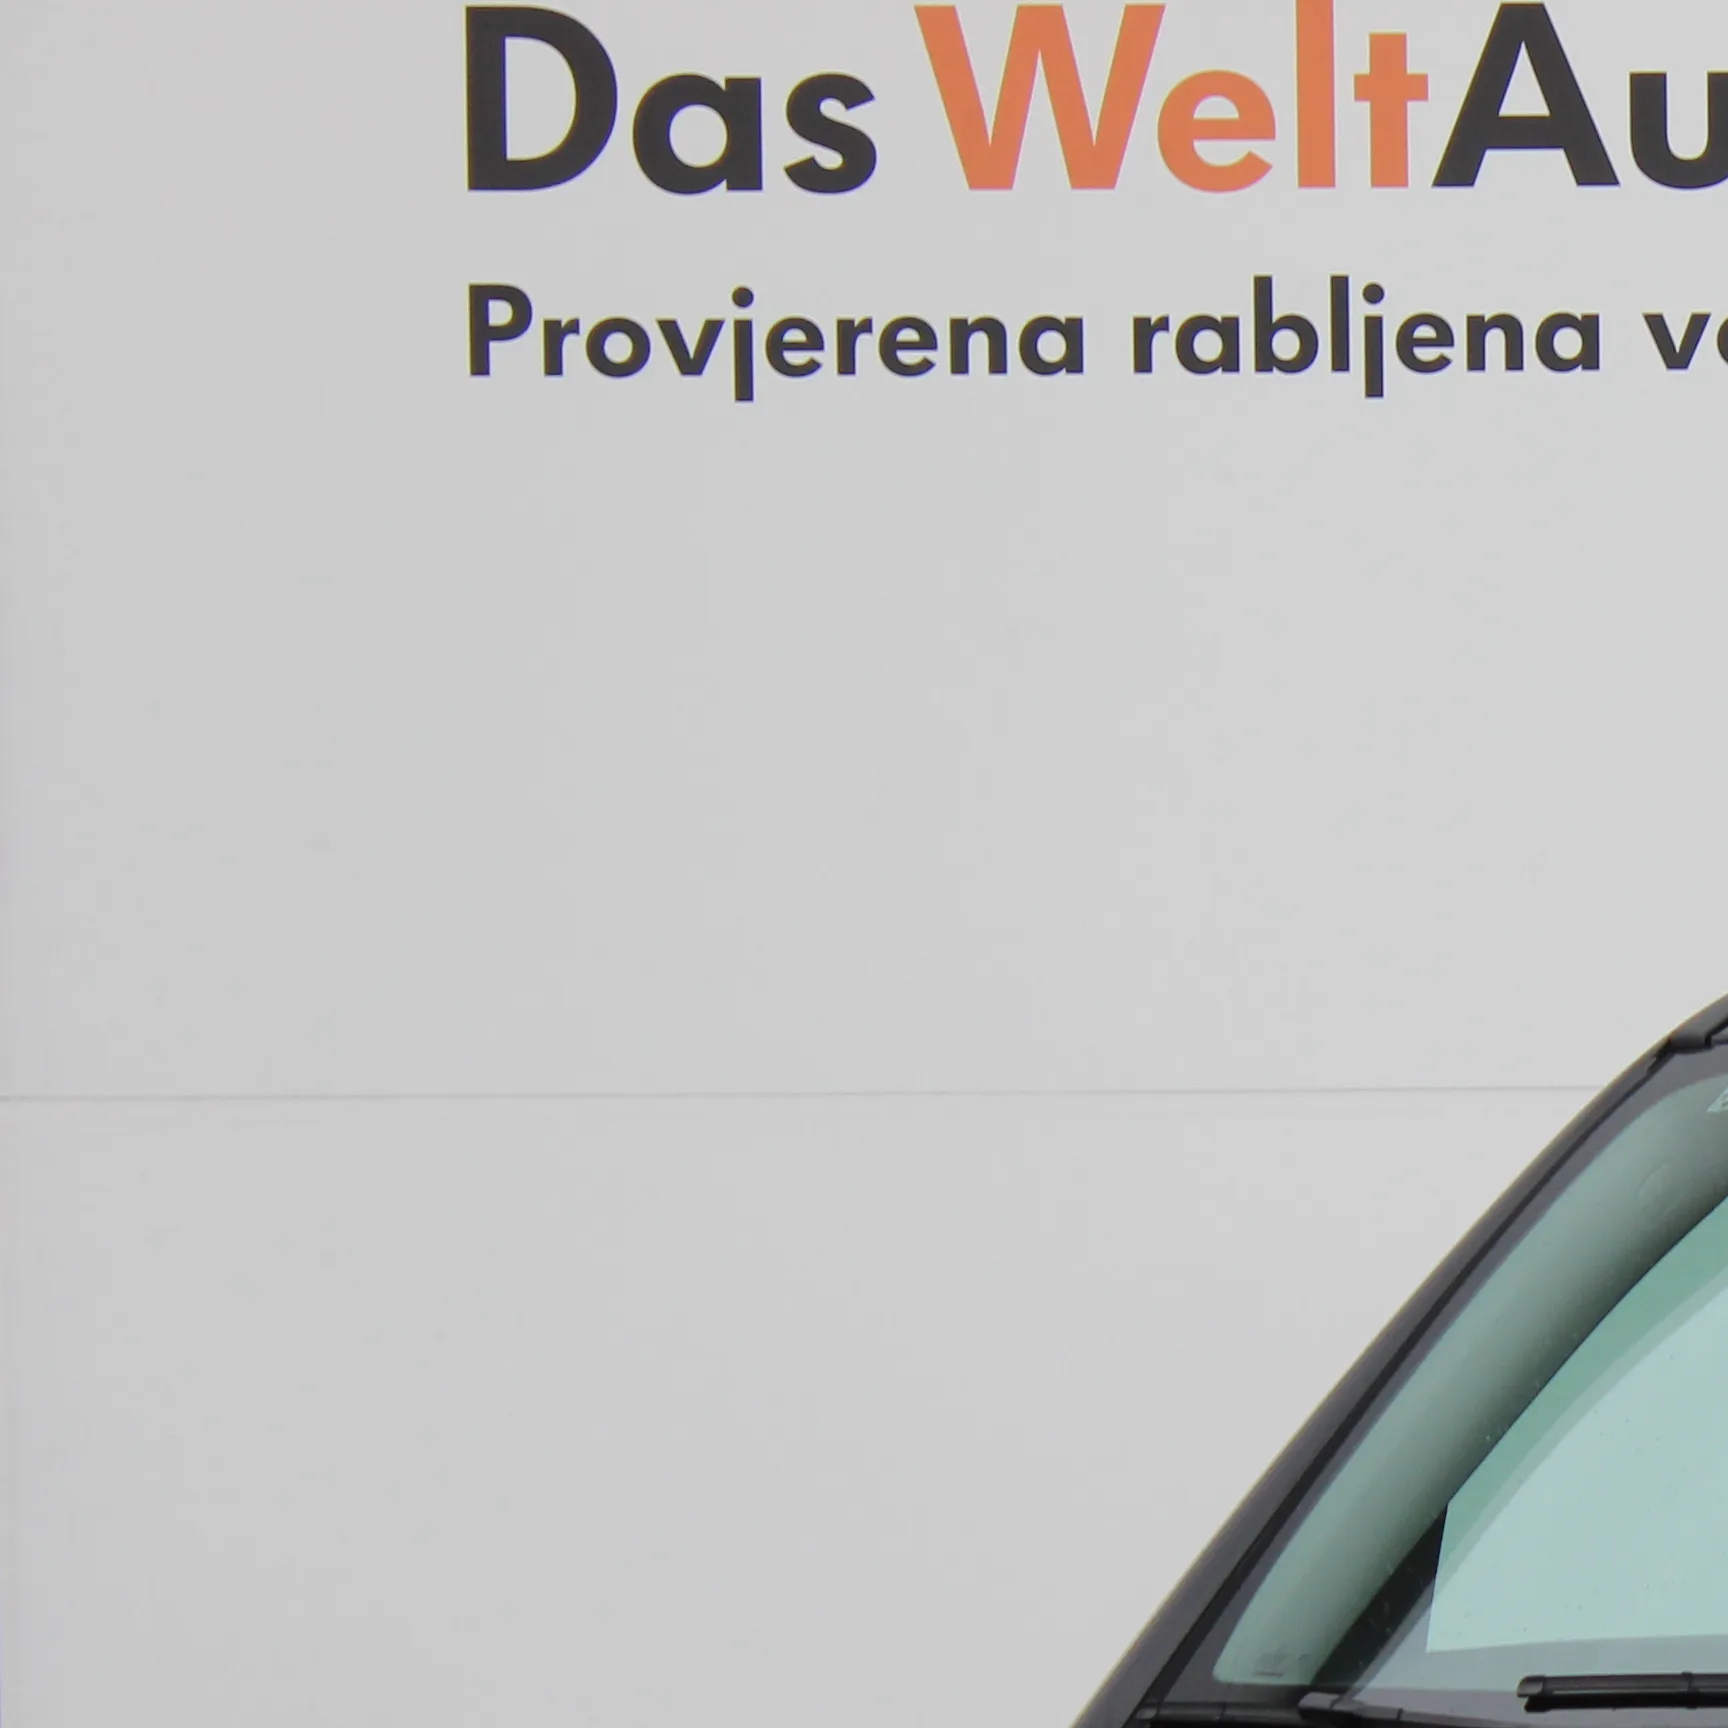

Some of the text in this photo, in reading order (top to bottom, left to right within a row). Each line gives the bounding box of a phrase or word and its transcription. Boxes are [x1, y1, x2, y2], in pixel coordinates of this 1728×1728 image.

[465, 4, 877, 196] Das
[467, 283, 1085, 403] Provjerena
[1132, 275, 1602, 399] rabljena
